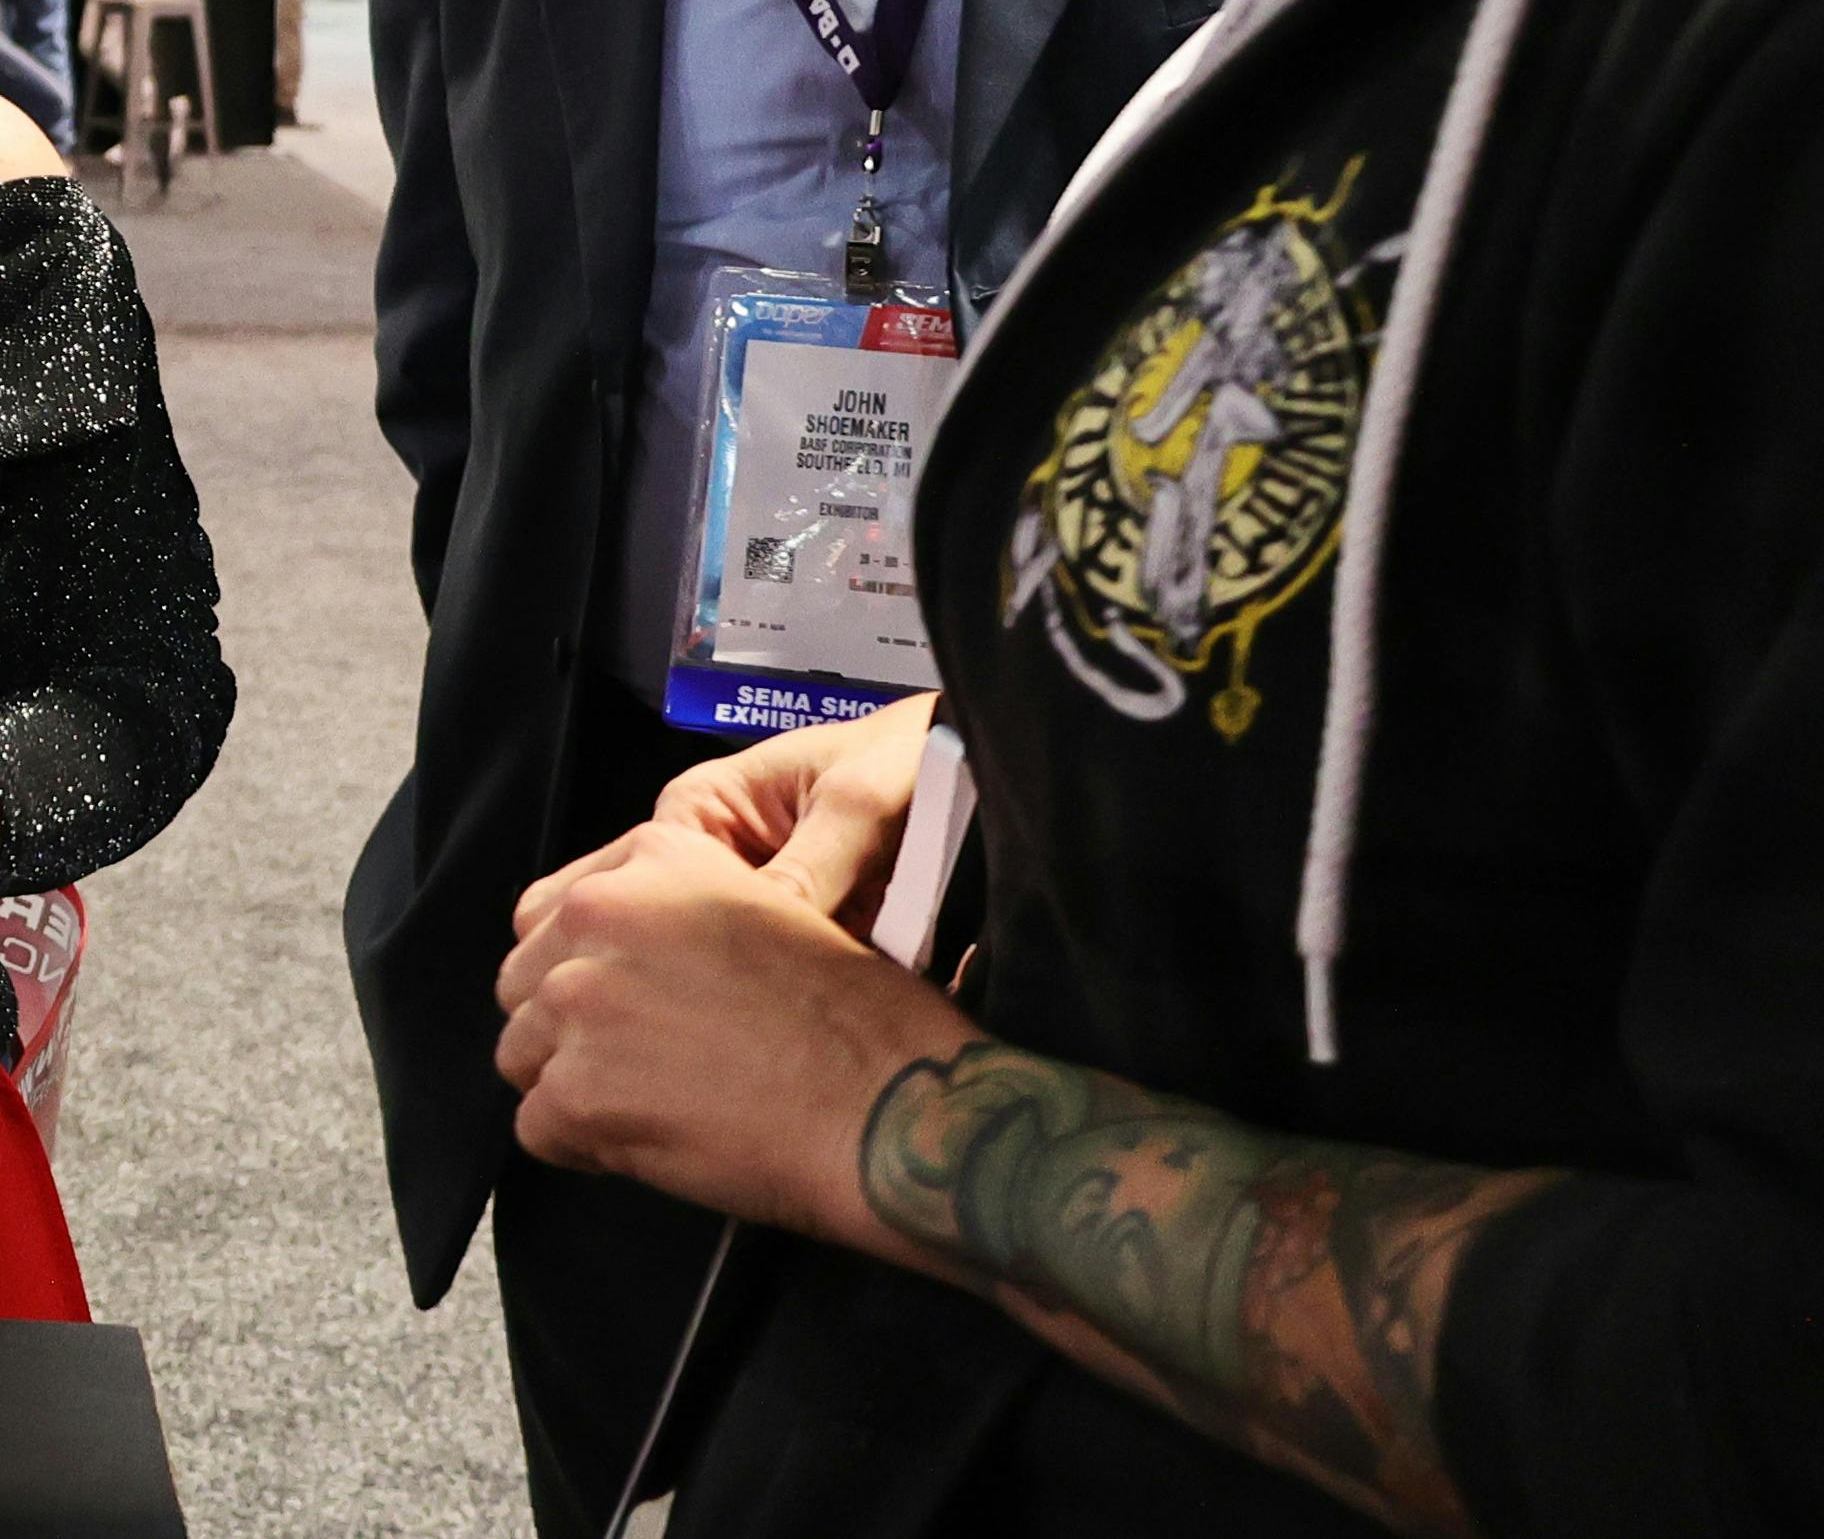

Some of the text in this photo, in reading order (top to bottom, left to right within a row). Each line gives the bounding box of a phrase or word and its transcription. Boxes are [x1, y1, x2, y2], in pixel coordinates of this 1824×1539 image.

[896, 312, 953, 336] SEM
[833, 389, 887, 416] JOHN
[805, 413, 910, 442] SHOEMAKER
[819, 502, 879, 521] EXHIBITOR
[737, 684, 887, 718] SEMA SHO
[714, 702, 842, 730] EXHIBIT
